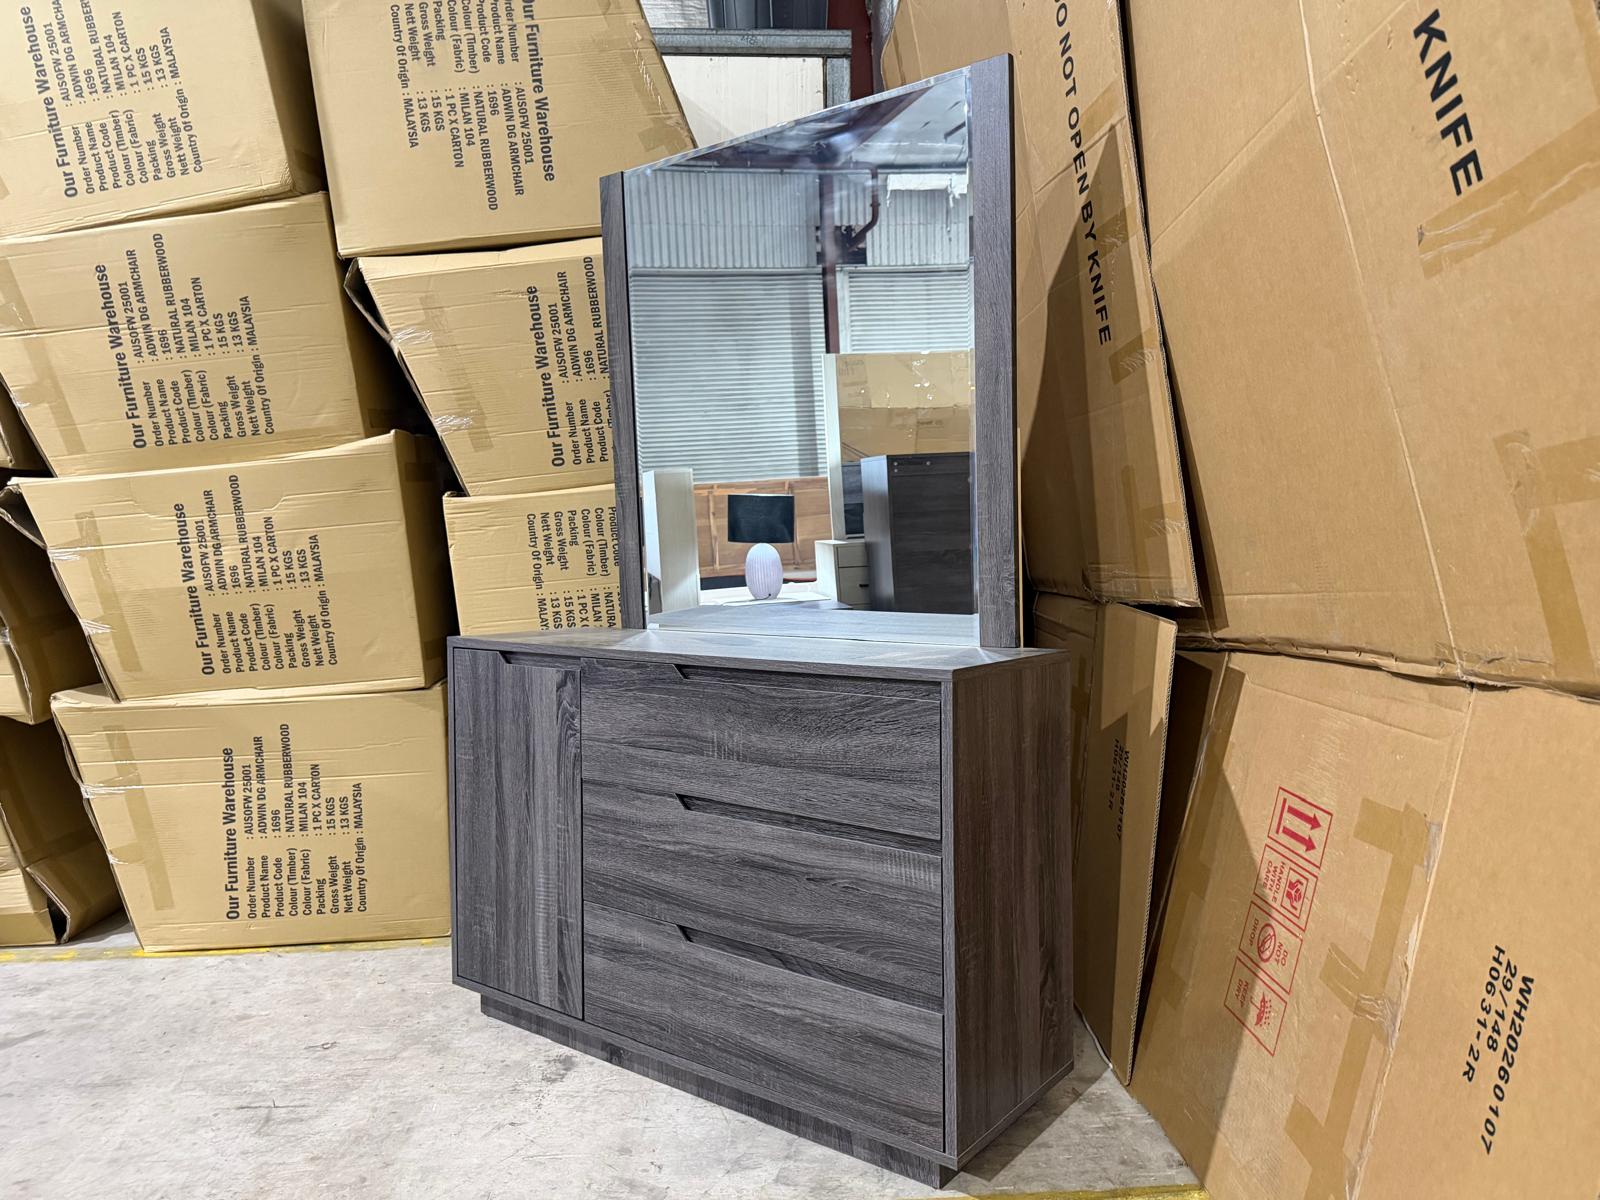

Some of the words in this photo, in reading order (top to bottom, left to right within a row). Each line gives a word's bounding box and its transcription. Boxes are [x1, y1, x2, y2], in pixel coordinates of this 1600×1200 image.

[390, 4, 403, 43] Country
[433, 0, 446, 41] Packing
[1055, 0, 1068, 27] O
[19, 6, 51, 95] Warehouse
[42, 21, 59, 56] 25001
[102, 34, 117, 54] 104
[159, 26, 180, 79] MALAYSIA
[395, 44, 407, 56] Of
[51, 57, 72, 101] AUSOFW
[108, 56, 126, 91] MILAN
[397, 58, 410, 88] Origin
[1059, 32, 1077, 98] NOT
[175, 88, 190, 119] Origin
[446, 102, 458, 117] PC
[524, 23, 544, 94] Furniture
[534, 96, 555, 182] Warehouse
[1413, 8, 1484, 197] KNIFE
[42, 96, 71, 168] Furniture
[122, 108, 143, 149] (Fabric)
[181, 120, 193, 132] Of
[402, 97, 419, 148] MALAYSIA
[448, 117, 459, 125] X
[71, 125, 88, 165] Number
[186, 133, 203, 173] Country
[449, 126, 465, 168] CARTON
[1068, 107, 1089, 195] OPEN
[81, 166, 95, 194] Order
[134, 150, 149, 184] Colour
[62, 170, 78, 198] Our
[1079, 201, 1097, 242] BY
[125, 248, 146, 304] ARMCHAIR
[152, 232, 176, 306] RUBBERWOOD
[94, 264, 123, 350] Warehouse
[137, 305, 150, 322] DG
[556, 271, 574, 326] ARMCHAIR
[1087, 250, 1112, 346] KNIFE
[167, 307, 186, 354] NATURAL
[226, 310, 240, 332] KGS
[526, 285, 549, 370] Warehouse
[547, 302, 562, 335] 25001
[565, 327, 577, 342] DG
[141, 323, 158, 357] ADWIN
[231, 334, 243, 347] 13
[552, 336, 569, 378] AUSOFW
[567, 344, 582, 377] ADWIN
[582, 350, 596, 375] 1696
[114, 351, 140, 420] Furniture
[156, 378, 169, 407] Name
[180, 369, 200, 410] (Timber)
[240, 380, 256, 415] Weight
[540, 372, 561, 439] Furniture
[564, 401, 578, 438] Number
[578, 399, 590, 426] Name
[591, 401, 603, 425] Code
[131, 422, 147, 449] Our
[160, 407, 178, 445] Product
[191, 411, 205, 442] Colour
[247, 415, 261, 436] Nett
[551, 441, 565, 467] Our
[570, 439, 582, 465] Order
[581, 427, 596, 464] Product
[594, 426, 609, 462] Product
[228, 474, 248, 544] RUBBERWOOD
[539, 511, 552, 535] Nett
[553, 510, 564, 537] Gross
[580, 508, 591, 538] Colour
[173, 503, 195, 583] Warehouse
[251, 535, 264, 554] 104
[526, 513, 538, 549] Country
[239, 544, 255, 588] NATURAL
[308, 534, 324, 582] MALAYSIA
[531, 550, 542, 561] Of
[542, 533, 555, 566] Weight
[556, 538, 569, 571] Weight
[582, 539, 598, 576] (Fabric)
[228, 564, 242, 589] 1696
[254, 556, 269, 587] MILAN
[532, 562, 545, 590] Origin
[186, 585, 210, 649] Furniture
[316, 589, 330, 617] Origin
[550, 597, 561, 609] 13
[563, 595, 574, 608] 15
[565, 608, 577, 628] KGS
[590, 592, 602, 621] MILAN
[238, 612, 251, 636] Code
[248, 602, 267, 640] (Timber)
[263, 603, 281, 639] (Fabric)
[320, 618, 332, 629] Of
[551, 610, 563, 629] KGS
[200, 651, 215, 675] Our
[242, 636, 258, 672] Product
[258, 642, 271, 671] Colour
[272, 640, 285, 670] Colour
[324, 630, 338, 666] Country
[252, 735, 267, 785] ARMCHAIR
[279, 723, 294, 789] RUBBERWOOD
[221, 747, 236, 825] Warehouse
[241, 763, 252, 793] 25001
[256, 786, 266, 801] DG
[297, 781, 308, 799] 104
[309, 763, 321, 801] CARTON
[242, 794, 254, 835] AUSOFW
[256, 802, 267, 834] ADWIN
[270, 808, 281, 833] 1696
[283, 790, 295, 833] NATURAL
[297, 802, 308, 832] MILAN
[311, 810, 322, 823] PC
[324, 796, 335, 817] KGS
[338, 795, 349, 816] KGS
[351, 782, 363, 829] MALAYSIA
[325, 818, 336, 830] 15
[339, 817, 350, 829] 13
[223, 828, 239, 892] Furniture
[285, 847, 299, 886] (Timber)
[299, 848, 313, 885] (Fabric)
[354, 836, 367, 864] Origin
[245, 856, 256, 892] Number
[259, 854, 269, 882] Name
[272, 857, 283, 881] Code
[327, 855, 340, 888] Weight
[341, 860, 354, 892] Weight
[354, 865, 365, 876] Of
[1262, 860, 1273, 889] CARE
[1268, 865, 1280, 893] WITH
[1272, 861, 1286, 903] HANDLE
[225, 894, 240, 920] Our
[246, 893, 257, 919] Order
[260, 882, 271, 918] Product
[273, 882, 285, 918] Product
[288, 887, 299, 917] Colour
[302, 886, 312, 916] Colour
[315, 877, 327, 915] Packing
[329, 888, 340, 914] Gross
[343, 893, 353, 913] Nett
[356, 876, 368, 912] Country
[1248, 919, 1259, 947] DROP
[1274, 941, 1284, 965] NOT
[1280, 950, 1288, 967] DO
[1235, 978, 1244, 999] DRY
[1462, 944, 1506, 1083] H0631-2R
[1486, 958, 1518, 1053] 29/148
[1481, 975, 1535, 1155] WH20260107
